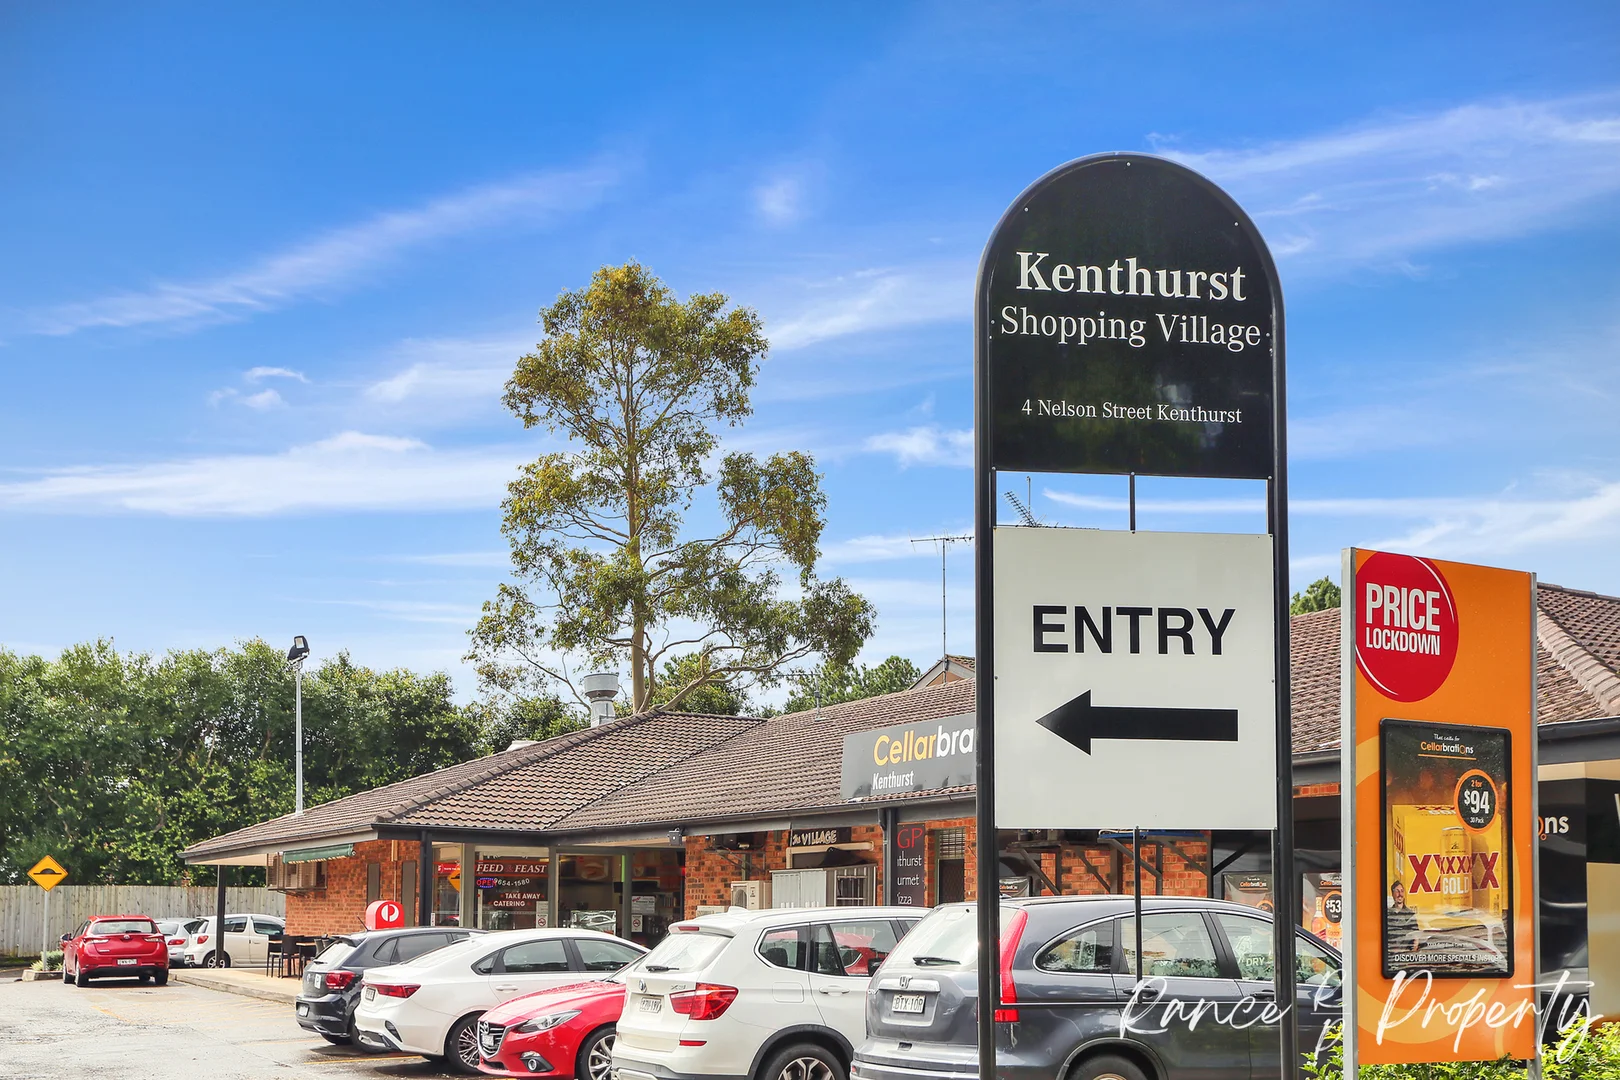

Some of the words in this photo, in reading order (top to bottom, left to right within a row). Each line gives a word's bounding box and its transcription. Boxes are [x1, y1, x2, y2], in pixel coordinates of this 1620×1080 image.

[1016, 251, 1247, 302] Kenthurst
[1000, 305, 1147, 348] Shopping
[1155, 312, 1261, 352] Village
[1021, 399, 1032, 416] 4
[1037, 399, 1098, 419] Nelson
[1102, 401, 1152, 420] Street
[1156, 403, 1243, 423] Kenthurst
[1365, 582, 1441, 633] PRICE
[1032, 604, 1236, 656] ENTRY
[1365, 626, 1441, 656] LOCKDOWN
[873, 724, 975, 767] Cellarbra
[1420, 741, 1474, 755] Cellarbrations
[872, 770, 915, 790] Kenthurst
[1471, 780, 1475, 788] 2
[1475, 780, 1483, 788] for
[1464, 788, 1490, 814] $94
[801, 829, 837, 846] VILLAGE
[476, 863, 504, 873] FEED
[514, 864, 547, 873] FEAST
[1442, 877, 1471, 895] GOLD
[1325, 899, 1341, 913] $53
[1246, 956, 1265, 967] DRY
[1394, 953, 1427, 962] DISCOVER
[1428, 954, 1447, 962] MORE
